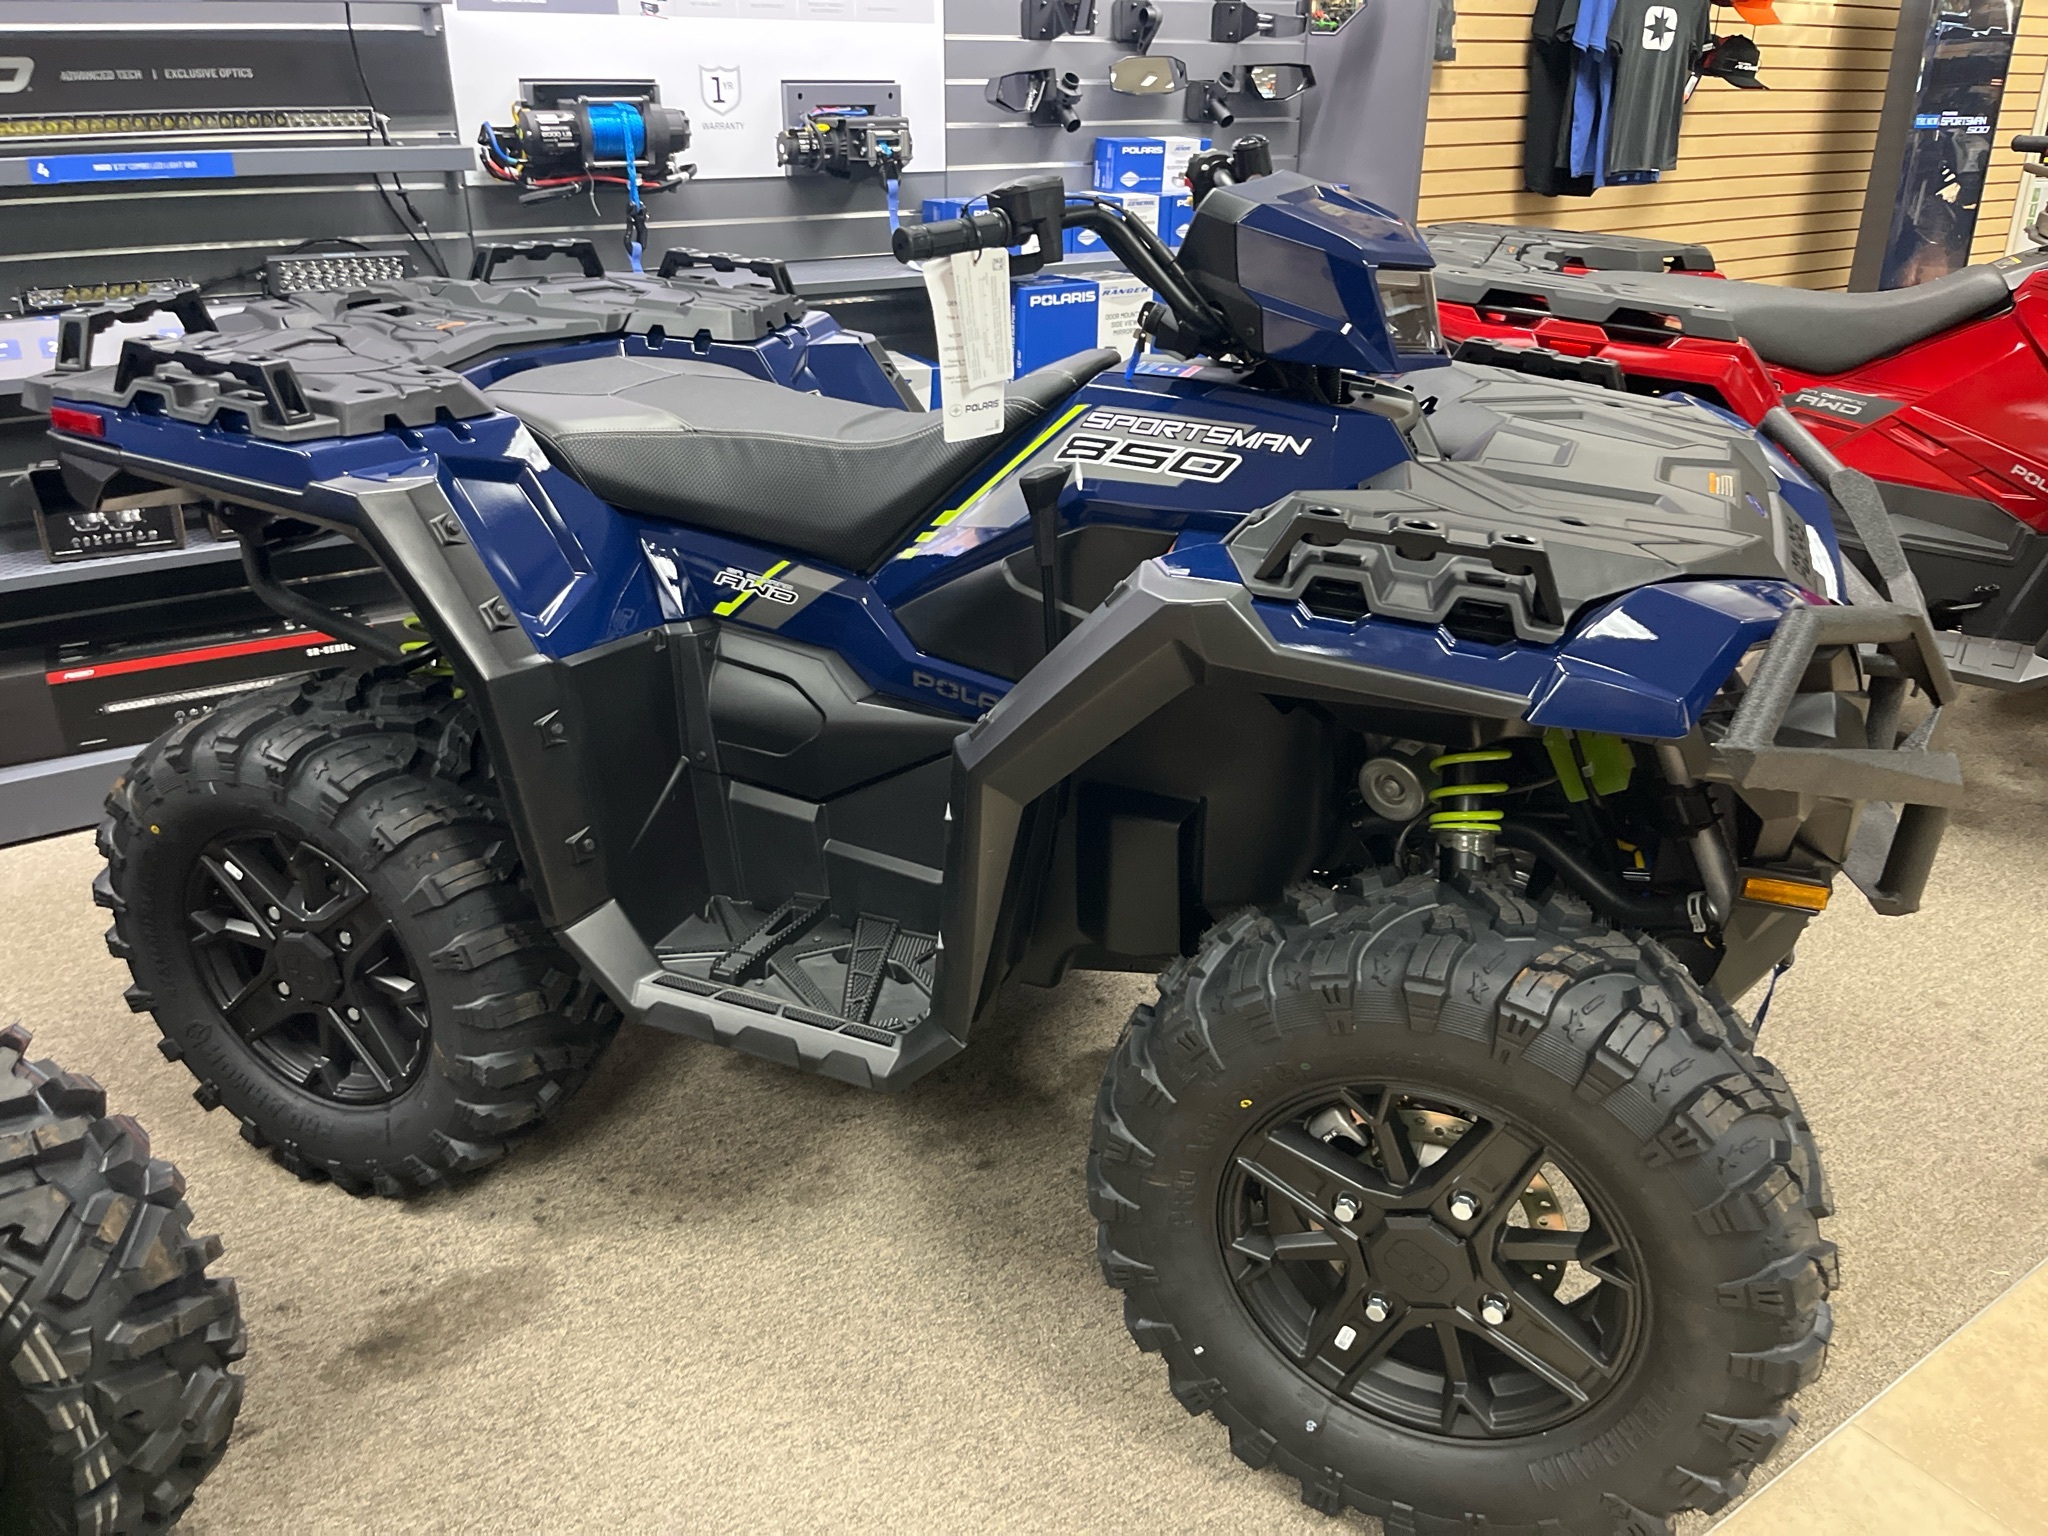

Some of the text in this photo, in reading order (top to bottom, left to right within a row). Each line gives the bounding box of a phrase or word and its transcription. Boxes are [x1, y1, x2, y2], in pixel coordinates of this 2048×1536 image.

[164, 67, 253, 80] EXCLUSIVE OPTICS
[711, 76, 726, 104] 1
[702, 121, 745, 131] WARRANTY
[1940, 116, 1988, 126] SPORTSMAN
[1121, 145, 1165, 155] POLARIS
[1029, 290, 1097, 308] POLARIS
[1101, 286, 1149, 297] RANGER
[1104, 311, 1120, 320] DOOR
[964, 399, 1000, 414] POLARIS
[1795, 394, 1863, 416] AWD
[1820, 392, 1868, 407] DEMAND
[1081, 411, 1313, 456] SPORTSMAN
[1053, 432, 1243, 484] 850
[713, 571, 799, 605] AWD
